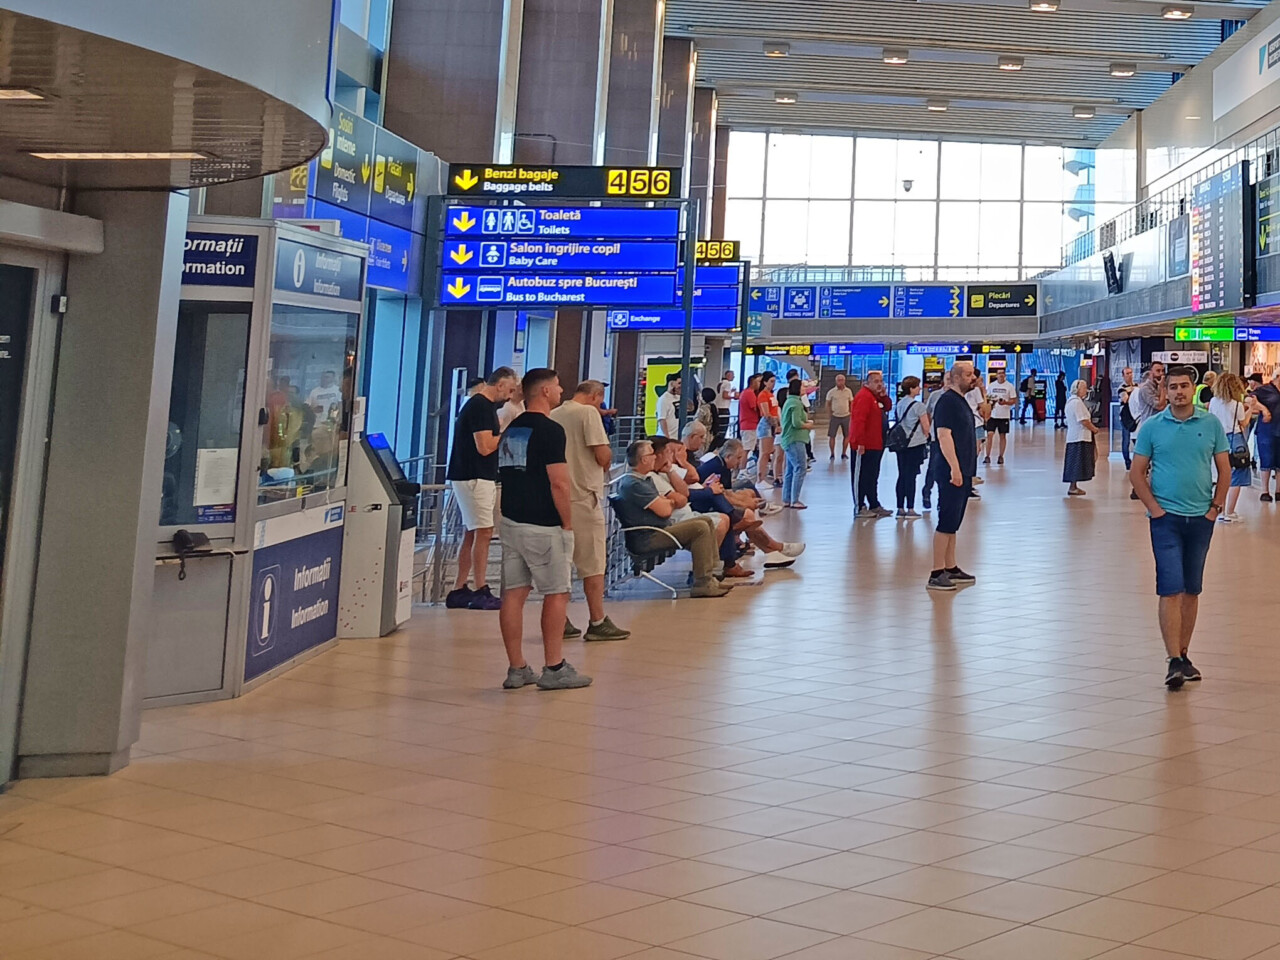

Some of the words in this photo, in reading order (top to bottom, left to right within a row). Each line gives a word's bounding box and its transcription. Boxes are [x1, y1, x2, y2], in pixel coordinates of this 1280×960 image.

[333, 161, 356, 184] Domestic
[483, 182, 528, 193] Baggage
[529, 181, 553, 191] belts
[484, 168, 517, 179] Benzi
[518, 168, 559, 182] bagaje
[610, 172, 624, 192] 4
[632, 172, 647, 192] 5
[653, 173, 668, 192] 6
[539, 210, 581, 221] Toaletă
[538, 225, 570, 235] Toilets
[184, 238, 244, 257] ormații
[510, 243, 541, 254] Salon
[541, 243, 591, 257] îngrijire
[592, 244, 621, 256] copil
[709, 243, 718, 257] 5
[722, 243, 732, 257] 6
[183, 261, 245, 275] rmation
[509, 256, 534, 267] Baby
[535, 256, 558, 266] Care
[507, 276, 554, 288] Autobuz
[555, 279, 584, 291] spre
[506, 292, 525, 301] Bus
[526, 293, 536, 301] to
[537, 292, 585, 301] Bucharest
[630, 315, 661, 323] Exchange
[294, 556, 332, 592] Informații
[291, 597, 329, 629] Information
